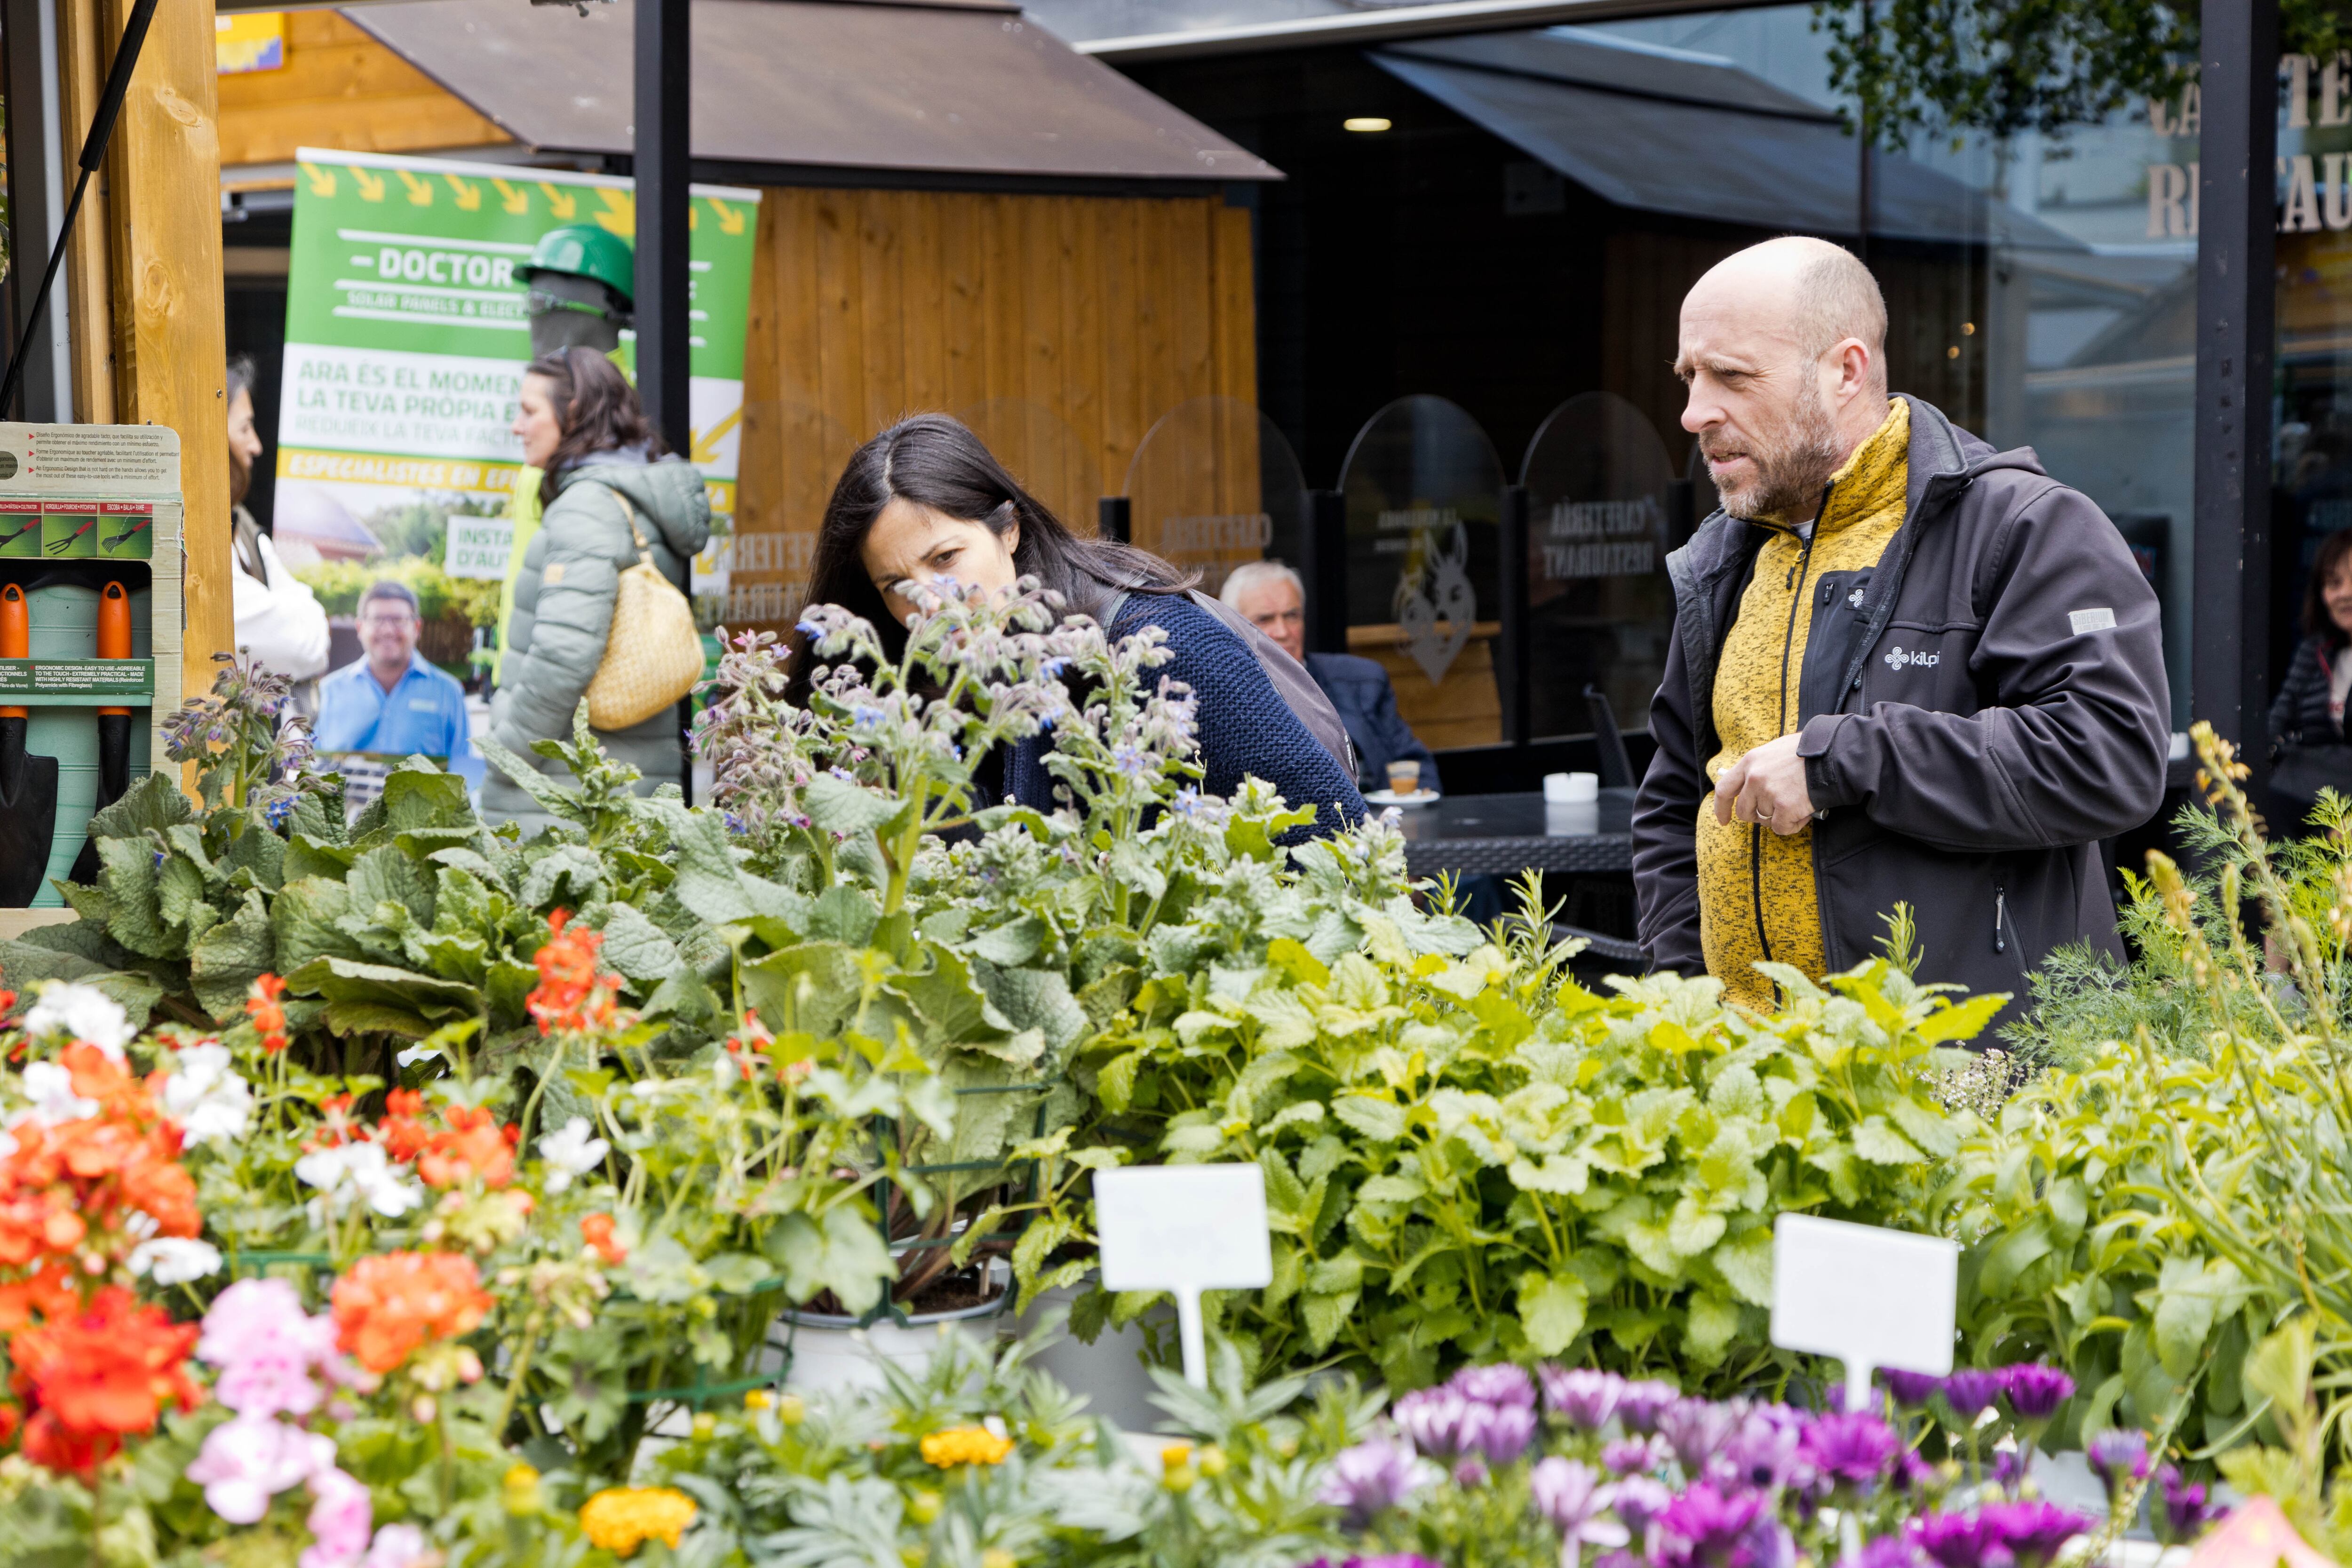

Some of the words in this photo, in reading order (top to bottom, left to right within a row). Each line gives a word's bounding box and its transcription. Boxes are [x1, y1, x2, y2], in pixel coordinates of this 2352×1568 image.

[378, 247, 515, 288] DOCTOR
[347, 290, 396, 308] SOLAR
[401, 295, 459, 314] PANELS
[463, 302, 476, 315] &
[299, 360, 350, 382] ARA
[357, 358, 386, 385] ÉS
[394, 368, 421, 389] EL
[297, 388, 326, 408] LA
[337, 391, 397, 413] TEVA
[383, 421, 404, 438] LA
[289, 454, 445, 485] ESPECIALISTES
[450, 467, 480, 488] EN
[1911, 651, 1940, 668] kilpi
